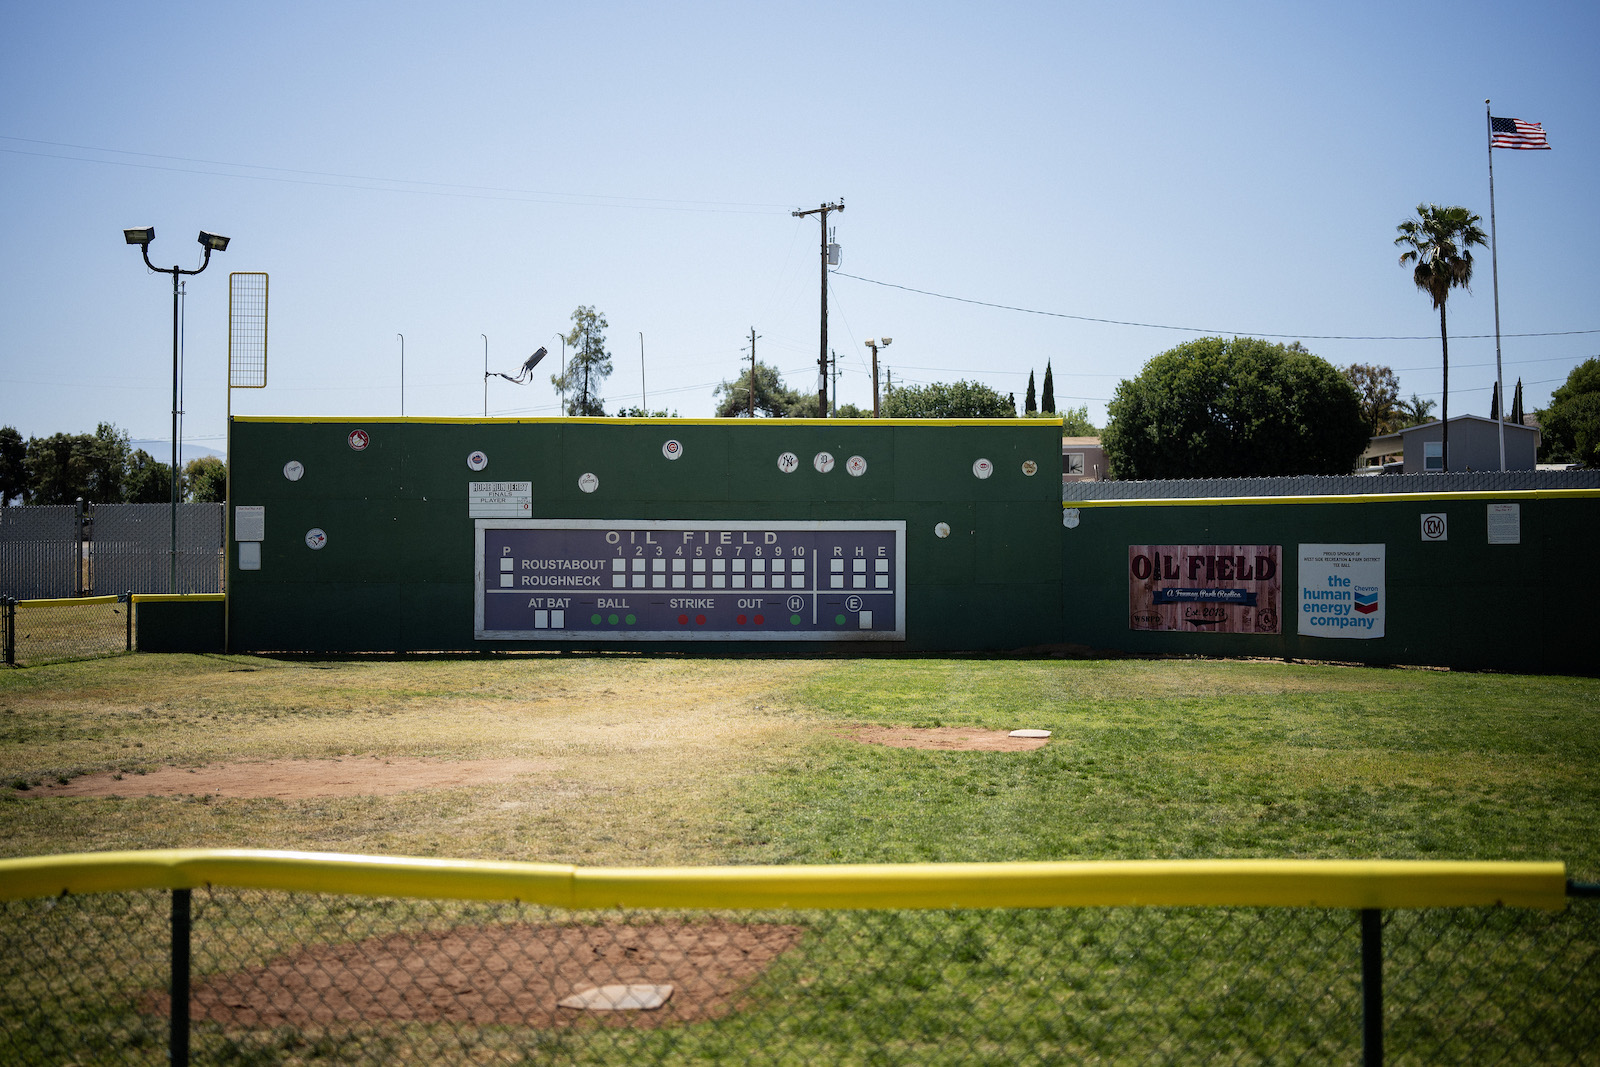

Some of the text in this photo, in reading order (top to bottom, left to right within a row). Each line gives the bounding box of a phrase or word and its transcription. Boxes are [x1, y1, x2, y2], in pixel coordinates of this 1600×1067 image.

[473, 483, 528, 492] HOME RUN DERBY
[605, 532, 778, 544] OIL FIELD
[503, 546, 885, 556] P 1 2 3 4 5 6 7 8 9 10 R H E
[521, 559, 606, 570] ROUSTABOUT
[1131, 551, 1277, 581] OIL FIELD
[521, 575, 601, 586] ROUGHNECK
[1327, 575, 1351, 587] the
[1166, 589, 1174, 597] A
[1200, 590, 1217, 598] Park
[1217, 590, 1242, 600] Replica
[1304, 587, 1351, 600] human
[528, 598, 858, 609] AT BAT BALL STRIKE OUT H E
[1303, 603, 1351, 615] energy
[1203, 607, 1225, 617] 2013
[1310, 616, 1375, 629] company
